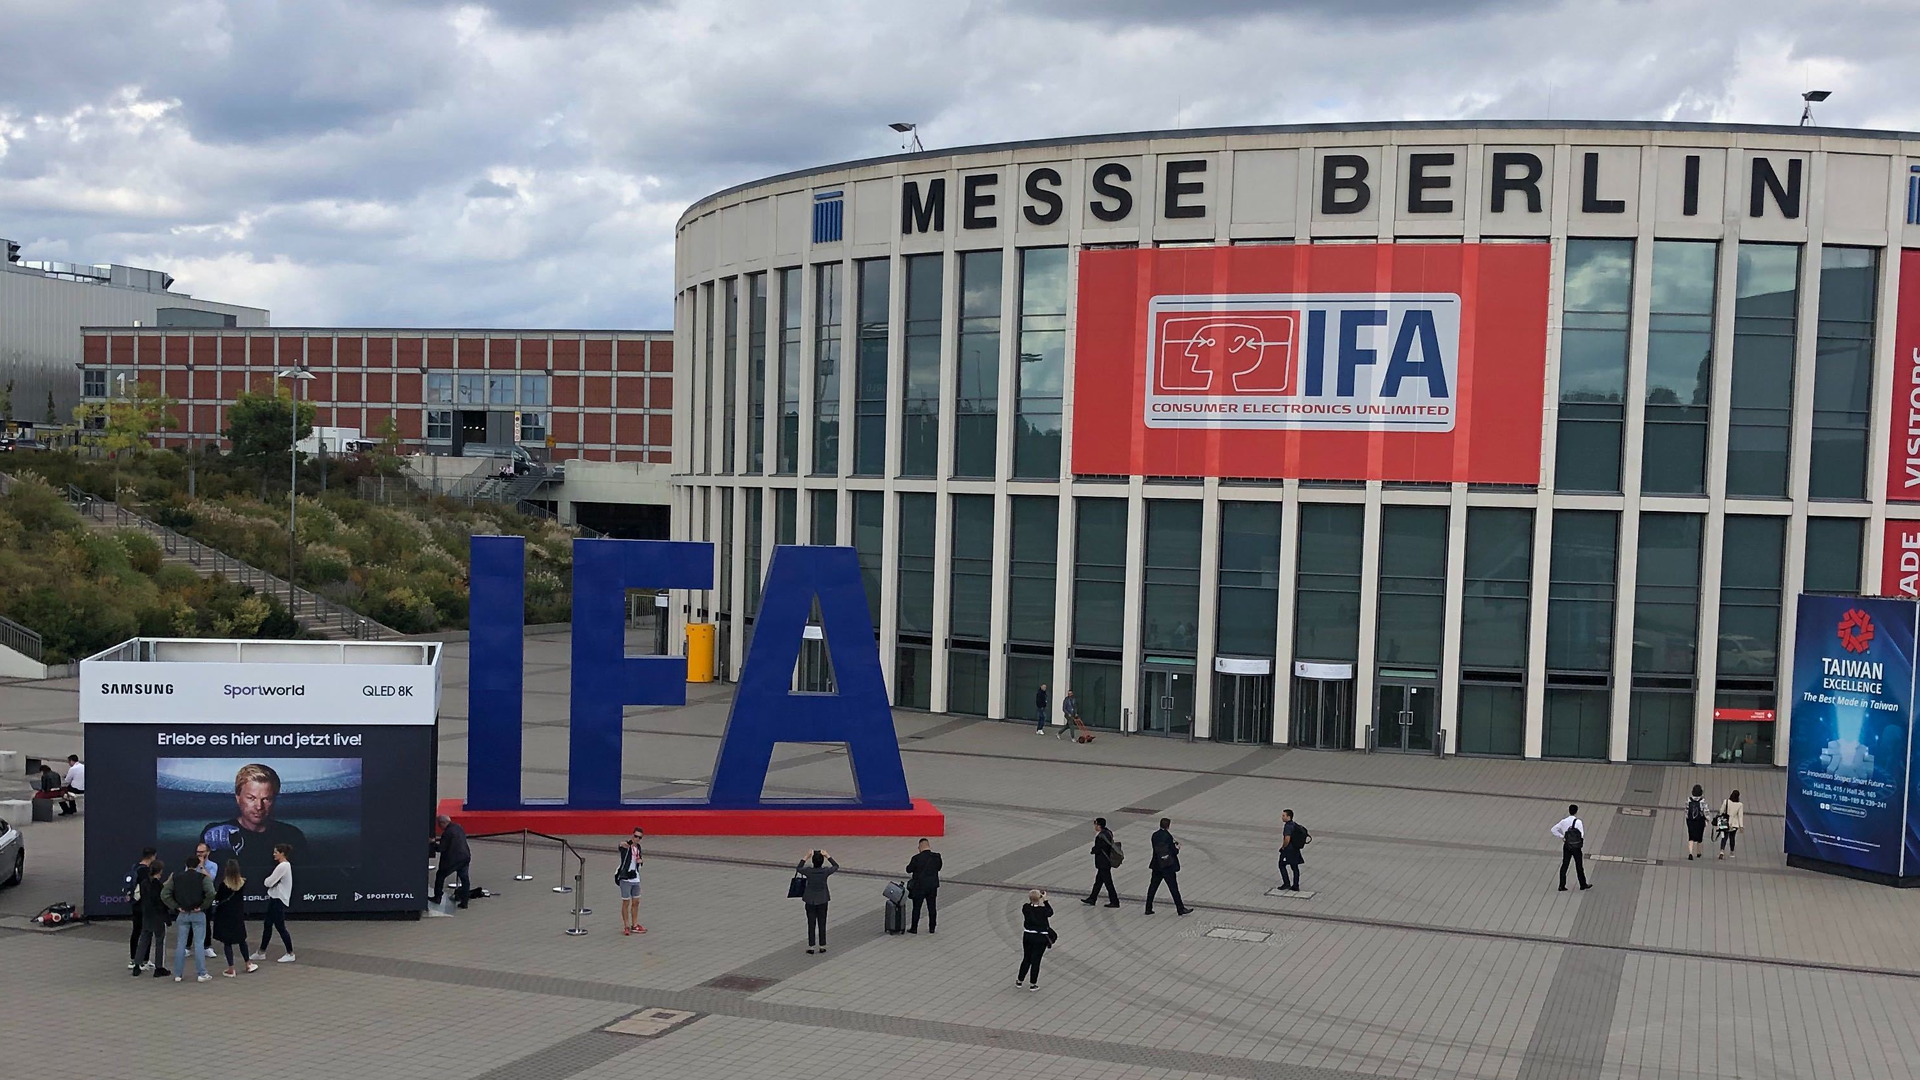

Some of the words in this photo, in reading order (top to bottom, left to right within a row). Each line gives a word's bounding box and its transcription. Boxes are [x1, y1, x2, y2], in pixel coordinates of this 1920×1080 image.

[902, 159, 1207, 235] MESSE
[1321, 152, 1802, 218] BERLIN
[1304, 309, 1450, 398] IFA
[1151, 402, 1239, 414] CONSUMER
[1243, 404, 1351, 415] ELECTRONICS
[1356, 405, 1450, 416] UNLIMITED
[1899, 532, 1920, 597] ADE
[465, 535, 913, 810] IFA
[1822, 657, 1884, 680] TAIWAN
[101, 683, 174, 695] SAMSUNG
[223, 684, 305, 699] Sportworld
[362, 685, 396, 697] QLED
[398, 685, 414, 697] 8K
[1823, 677, 1882, 694] EXCELLENCE
[1803, 692, 1817, 702] The
[1818, 693, 1836, 704] Best
[1836, 696, 1859, 707] Made
[1860, 699, 1868, 708] in
[1870, 700, 1899, 712] Taiwan
[157, 732, 206, 745] Erlebe
[209, 735, 228, 745] es
[231, 732, 260, 745] hier
[264, 733, 293, 746] und
[295, 732, 330, 749] jetzt
[333, 733, 362, 746] live!
[303, 893, 316, 902] sky
